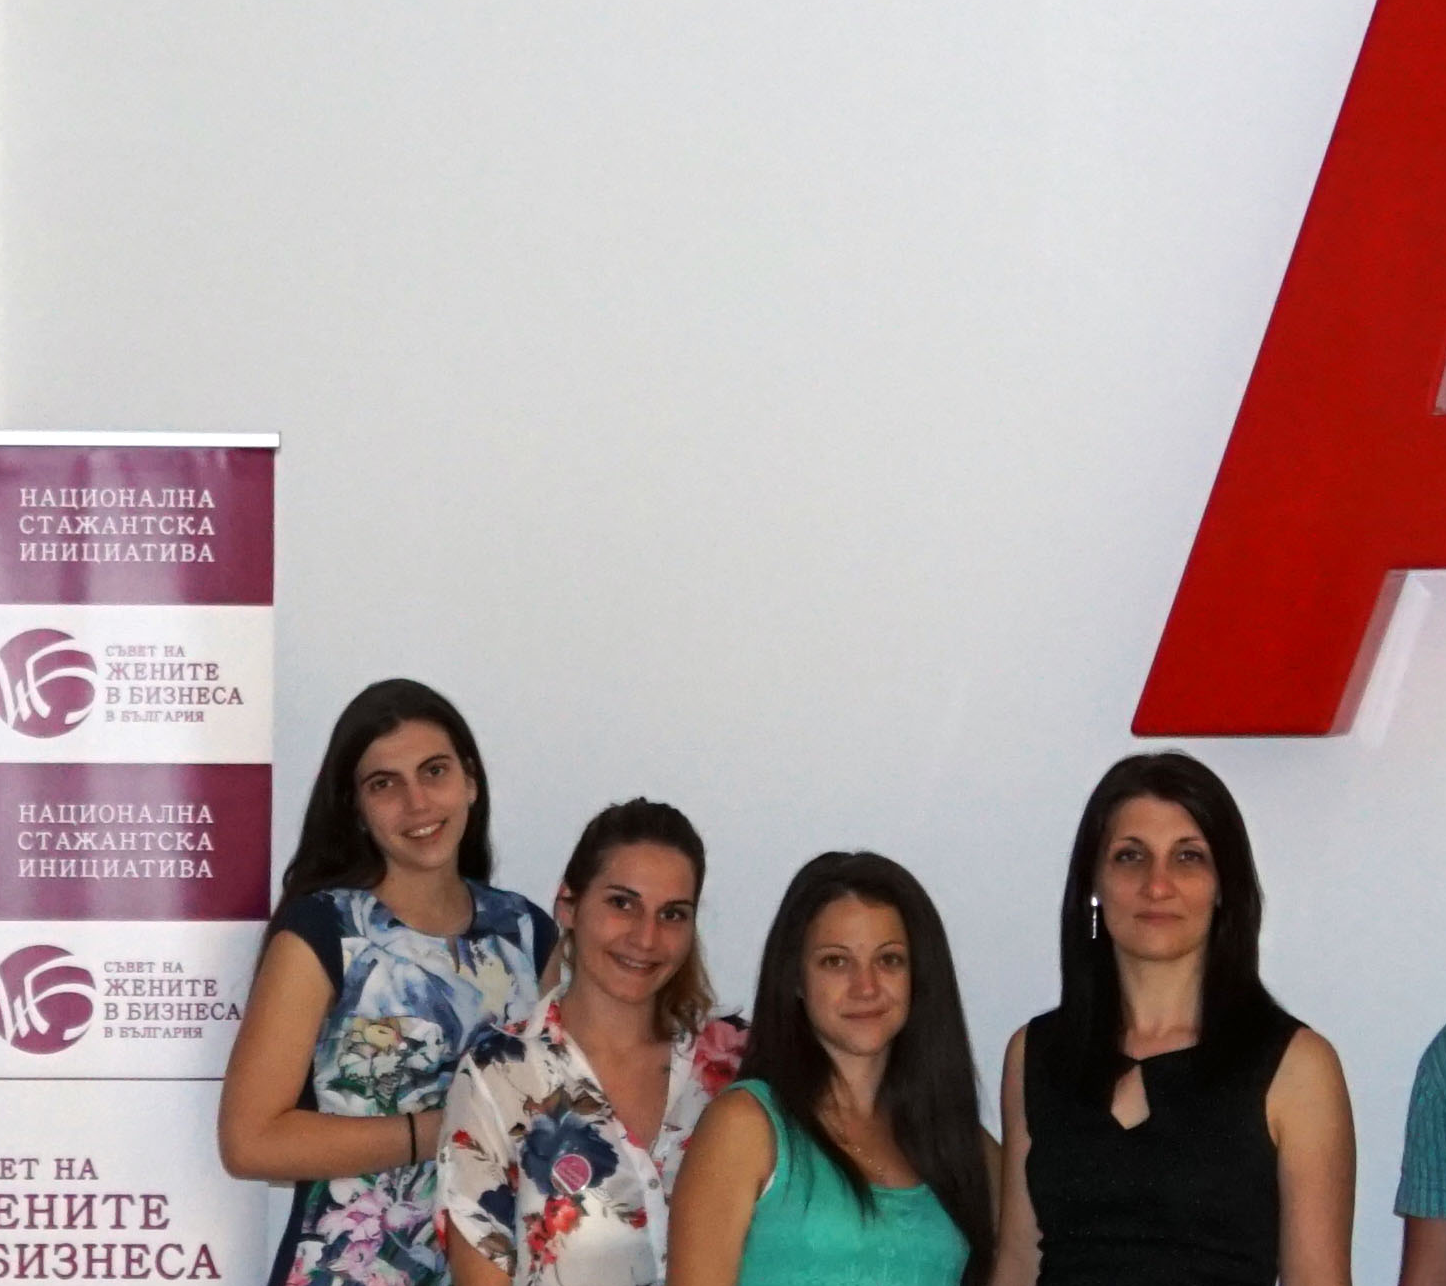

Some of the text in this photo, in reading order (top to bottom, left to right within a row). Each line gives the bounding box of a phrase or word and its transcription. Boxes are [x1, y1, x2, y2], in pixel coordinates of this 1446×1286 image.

[20, 488, 215, 509] НАЦИОНАЛНА
[20, 515, 215, 535] СТАЖАНТСКА
[20, 543, 215, 562] ИНИЦИАТИВА
[105, 645, 185, 657] СЪВЕТ НА
[107, 663, 219, 681] ЖЕНИТЕ
[106, 686, 244, 705] В БИЗНЕСА
[105, 710, 204, 722] В БЪЛГАРИЯ
[20, 804, 214, 826] НАЦИОНАЛНА
[18, 832, 214, 851] СТАЖАНТСКА
[19, 859, 213, 879] ИНИЦИАТИВА
[104, 962, 184, 973] СЪВЕТ НА
[105, 979, 217, 997] ЖЕНИТЕ
[104, 1002, 243, 1021] В БИЗНЕСА
[104, 1027, 203, 1038] В БЪЛГАРИЯ
[55, 1158, 98, 1180] НА
